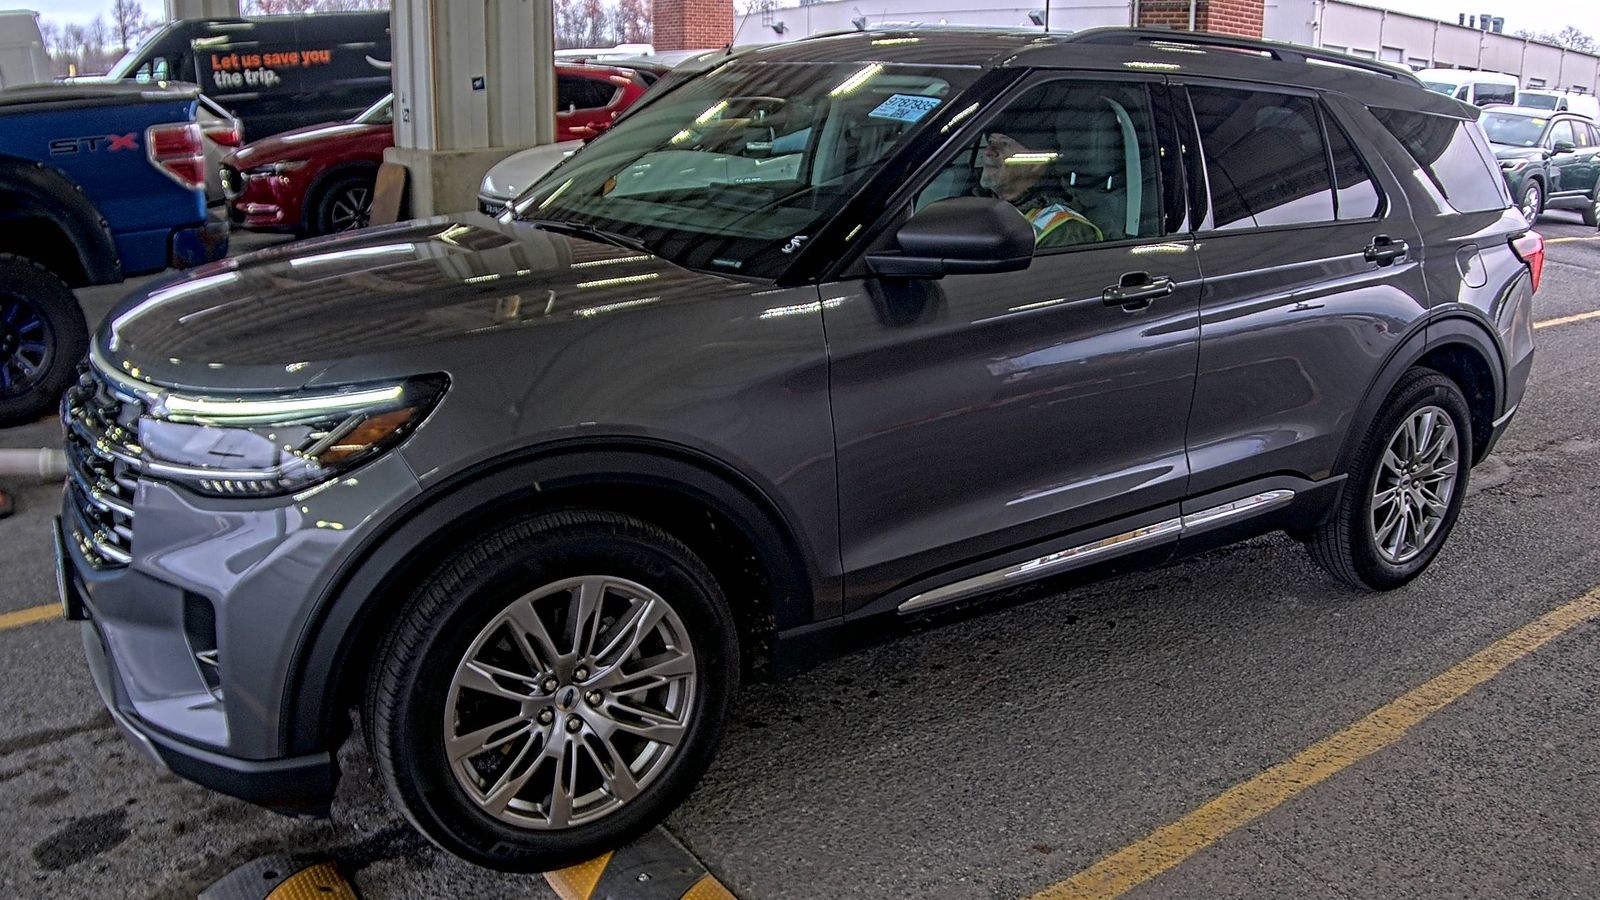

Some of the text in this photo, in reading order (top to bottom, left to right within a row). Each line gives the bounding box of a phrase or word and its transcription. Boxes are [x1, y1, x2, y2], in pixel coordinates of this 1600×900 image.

[211, 49, 331, 71] Let us save you
[213, 67, 280, 88] the trip.
[49, 132, 139, 155] STX
